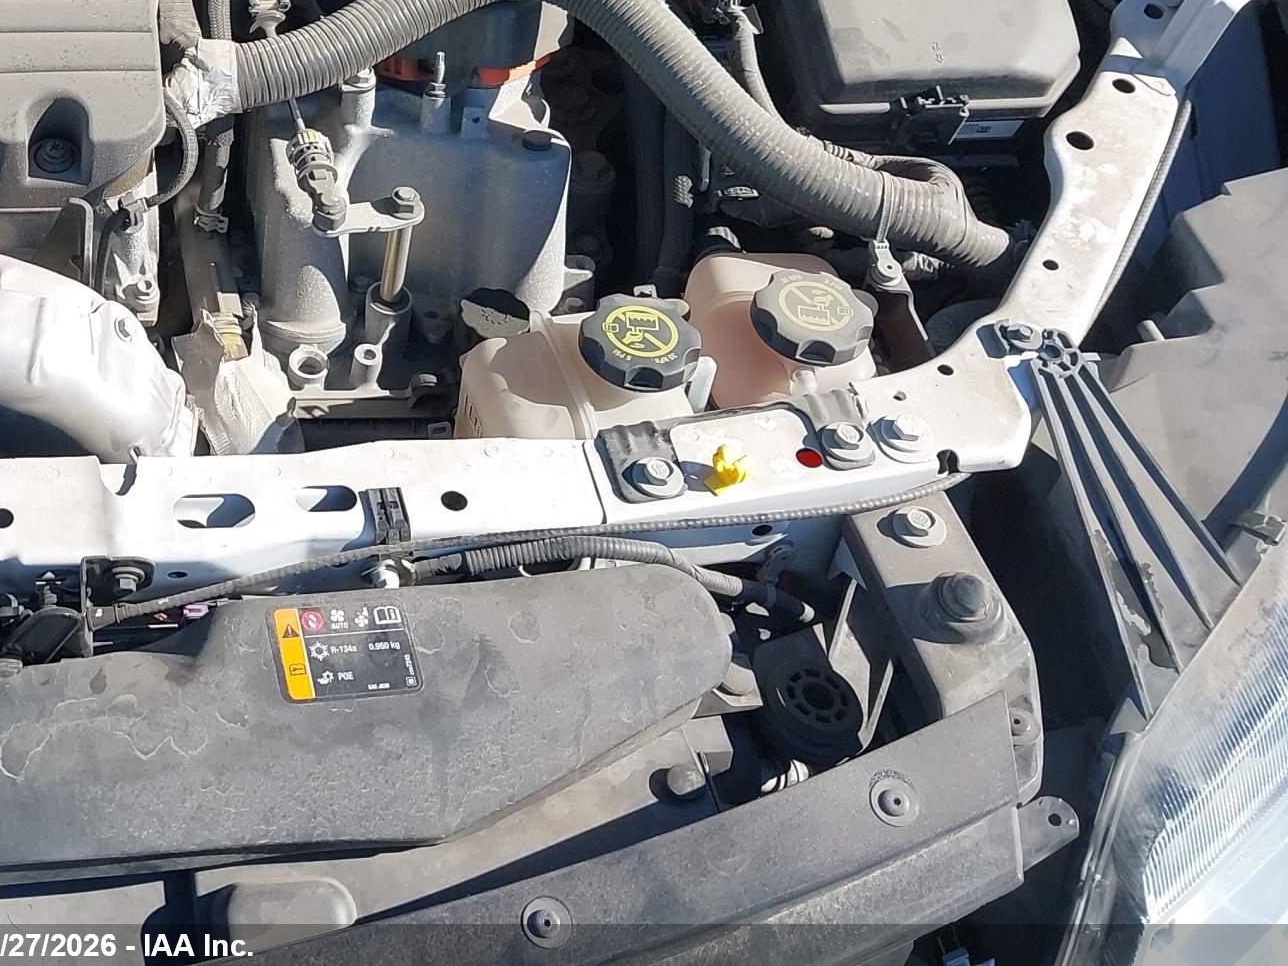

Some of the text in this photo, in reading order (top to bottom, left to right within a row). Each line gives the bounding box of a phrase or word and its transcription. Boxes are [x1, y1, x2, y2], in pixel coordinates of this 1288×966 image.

[330, 641, 401, 654] R-134a 0.950 kg
[337, 671, 355, 681] POE
